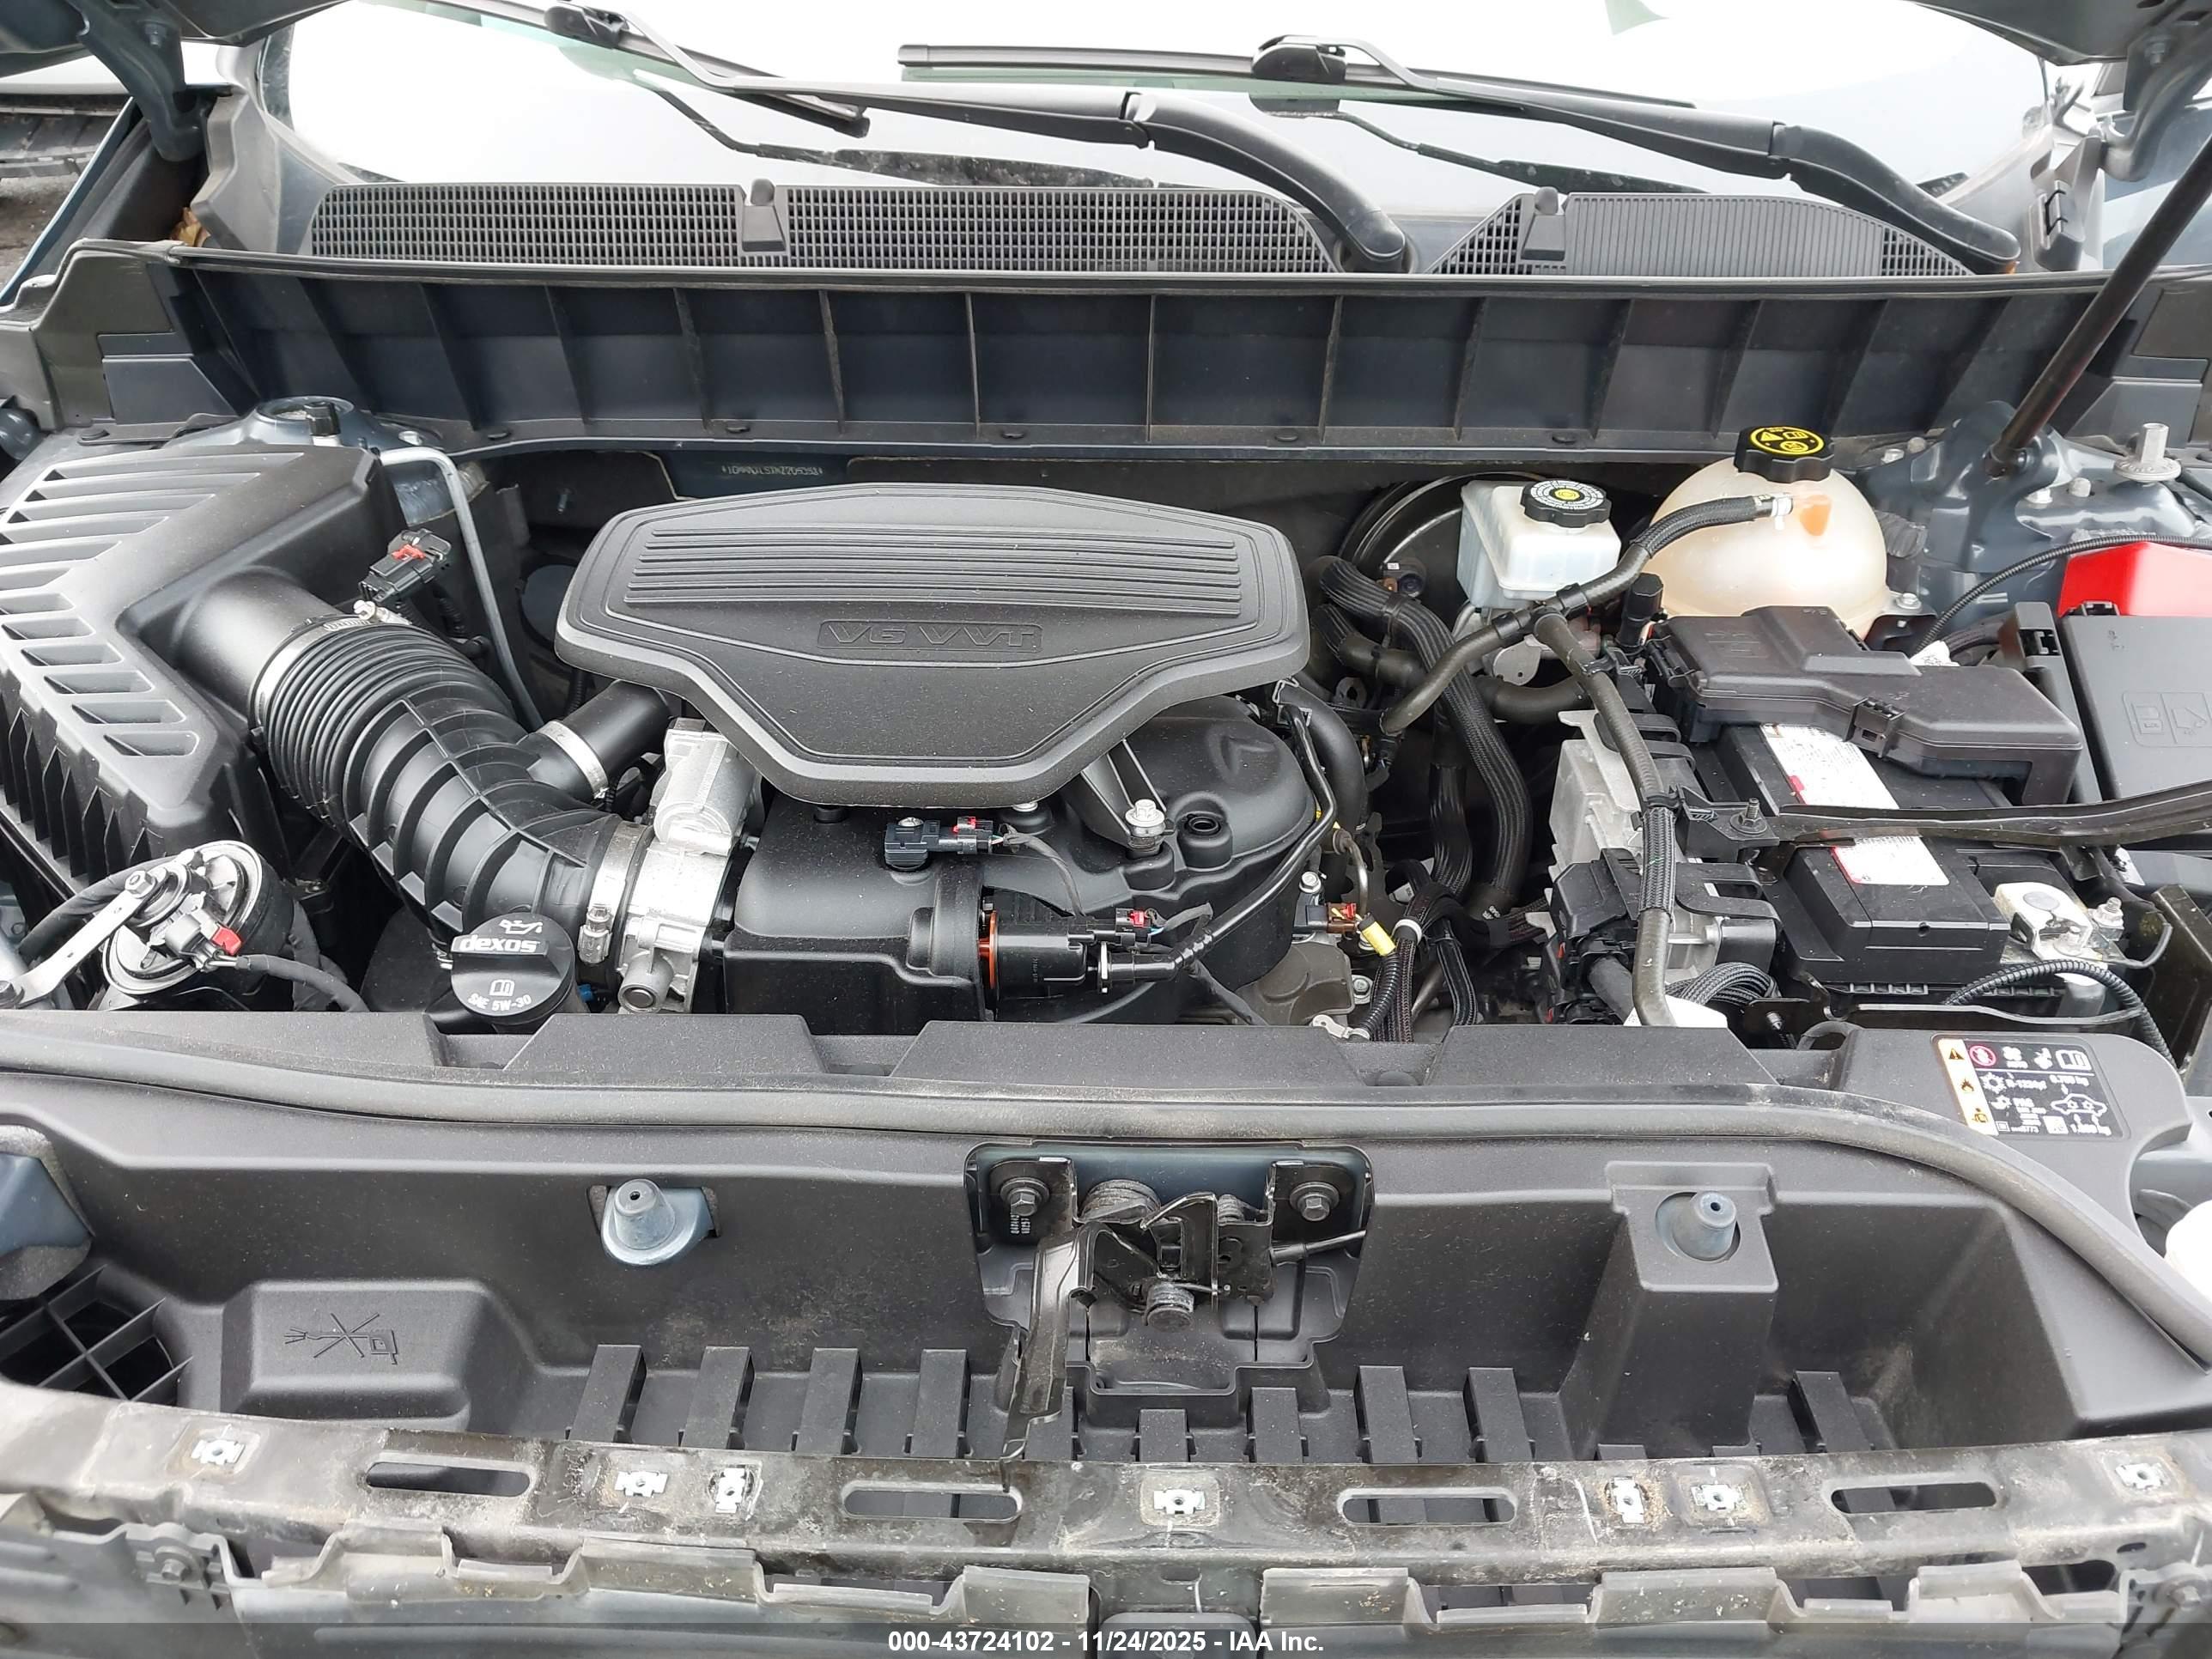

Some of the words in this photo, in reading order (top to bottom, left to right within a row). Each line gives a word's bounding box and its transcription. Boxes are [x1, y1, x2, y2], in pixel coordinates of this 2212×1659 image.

[828, 624, 907, 644] V6
[918, 625, 1035, 647] VVT
[459, 934, 540, 953] dexos
[467, 993, 490, 1010] SAE
[491, 994, 532, 1012] 5W-30
